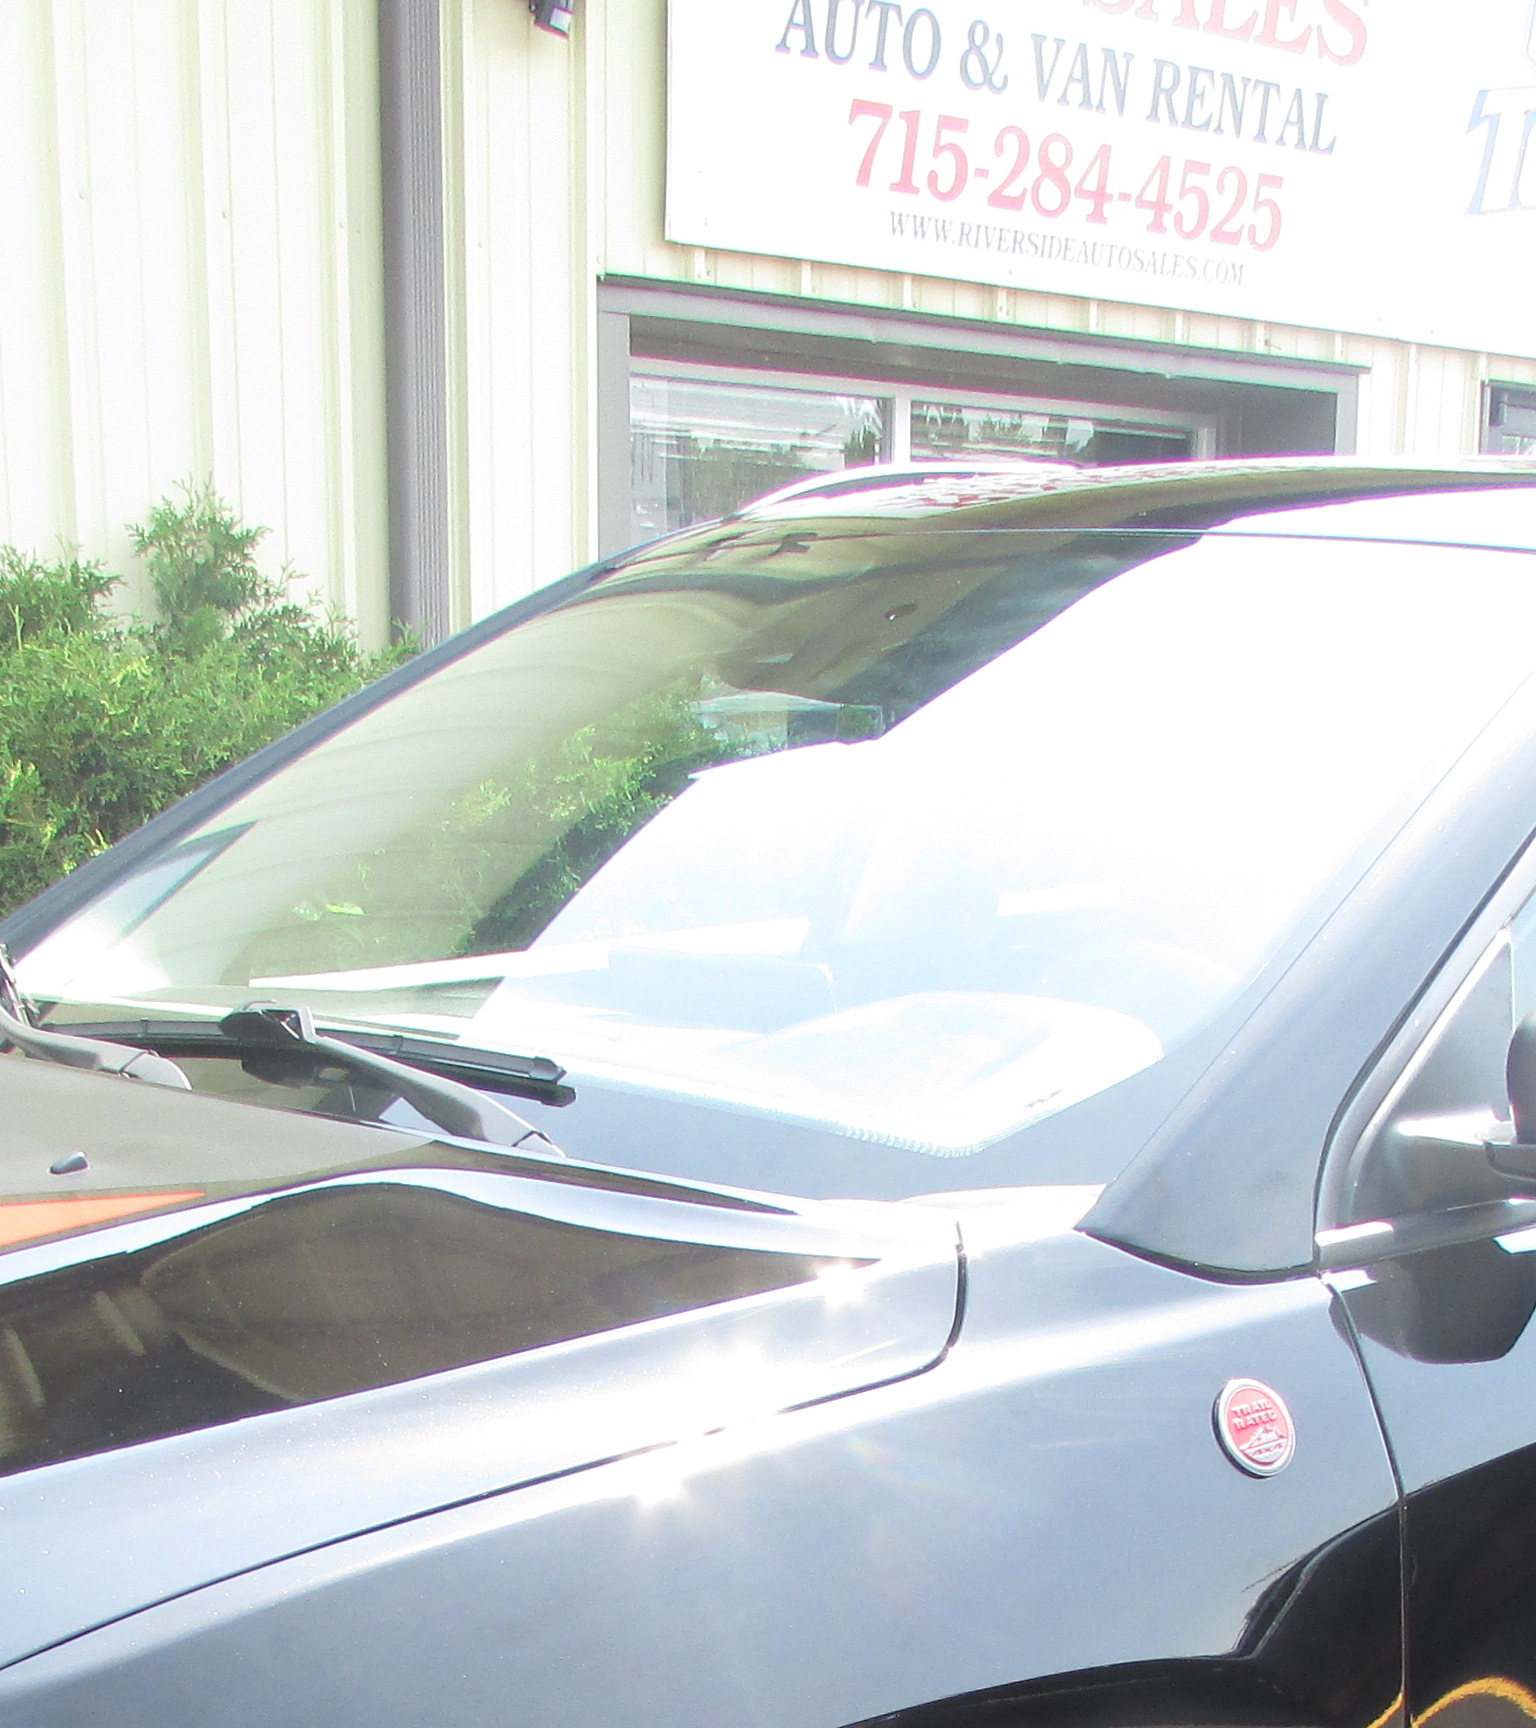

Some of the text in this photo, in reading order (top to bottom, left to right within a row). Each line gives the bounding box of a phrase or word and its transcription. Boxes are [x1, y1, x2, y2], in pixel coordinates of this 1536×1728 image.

[775, 0, 1337, 155] AUTO & VAN RENTAL
[1082, 0, 1367, 66] LES
[848, 98, 1284, 252] 715-284-4525
[889, 211, 1245, 287] WWW.RIVERSIDEAUTOSALES.COM
